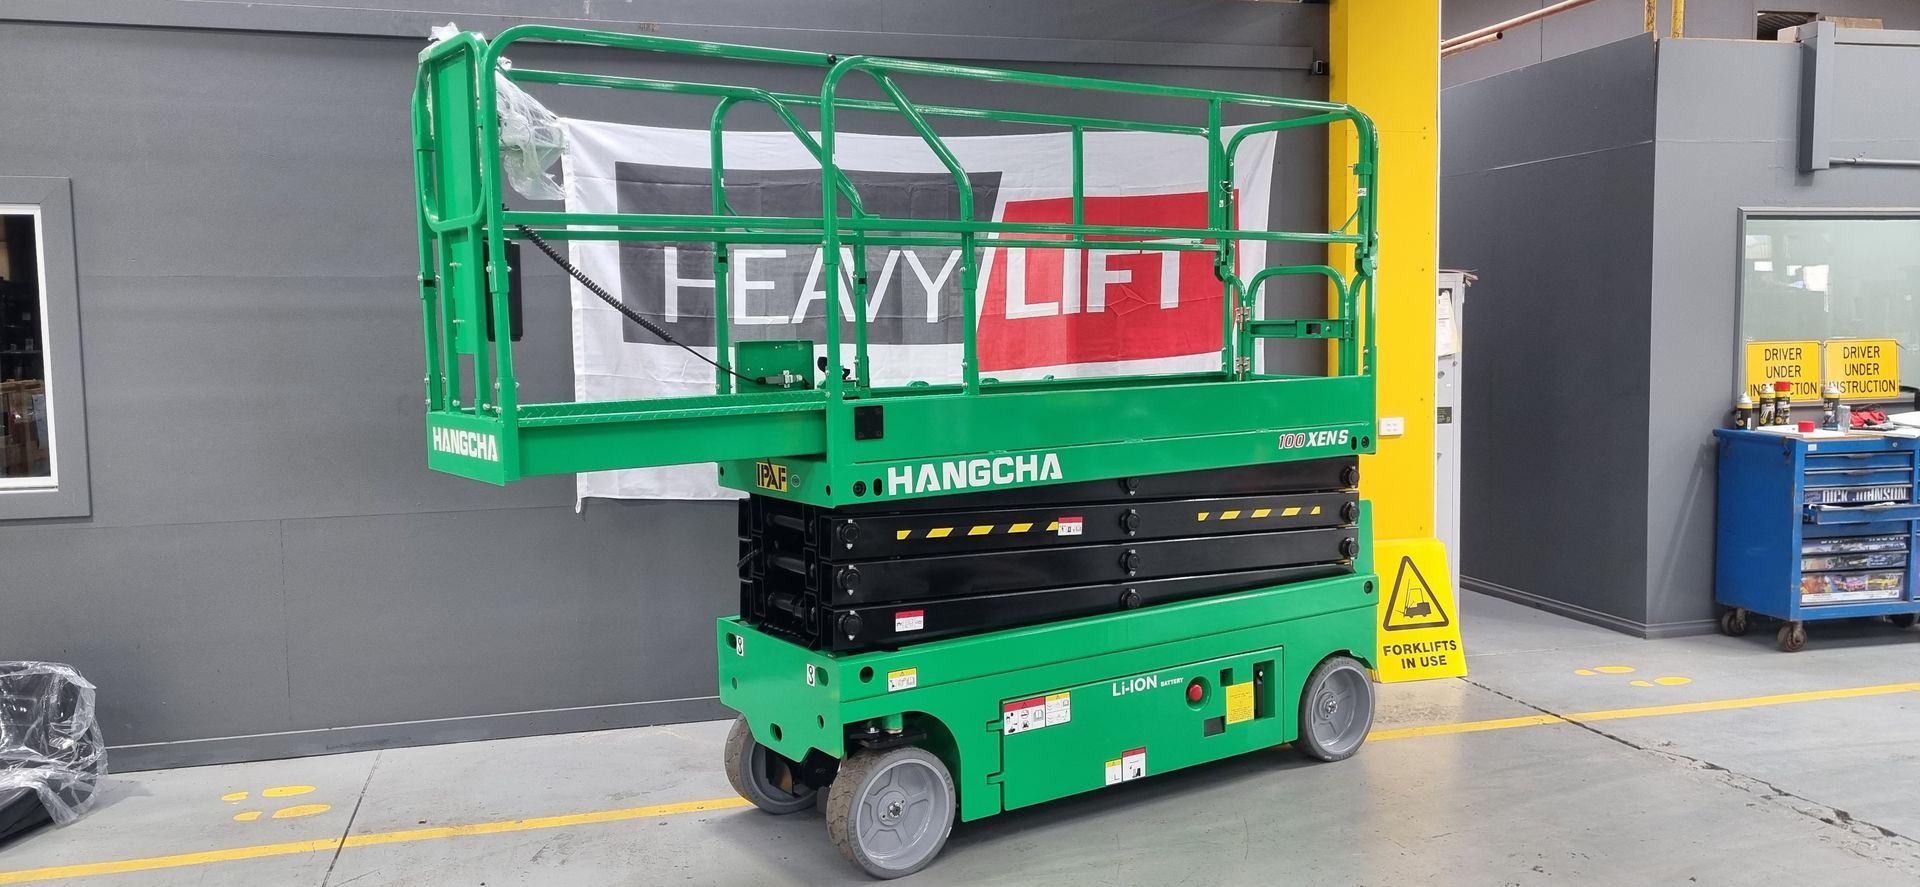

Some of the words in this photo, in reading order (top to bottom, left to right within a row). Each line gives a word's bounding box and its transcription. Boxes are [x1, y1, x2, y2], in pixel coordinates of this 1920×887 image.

[664, 246, 963, 325] HEAVY
[1005, 238, 1201, 320] LIFT
[1764, 347, 1803, 361] DRIVER
[1843, 345, 1881, 359] DRIVER
[1766, 365, 1802, 379] UNDER
[1844, 362, 1880, 376] UNDER
[1750, 382, 1818, 397] INTION
[432, 426, 499, 462] HANGCHA
[757, 458, 786, 490] IPAF
[887, 453, 1063, 496] HANGCHA
[1383, 640, 1457, 656] FORKLIFTS
[1401, 658, 1417, 669] IN
[1420, 655, 1447, 667] USE
[1112, 674, 1157, 697] Li-ION
[1160, 677, 1184, 687] BATTERY
